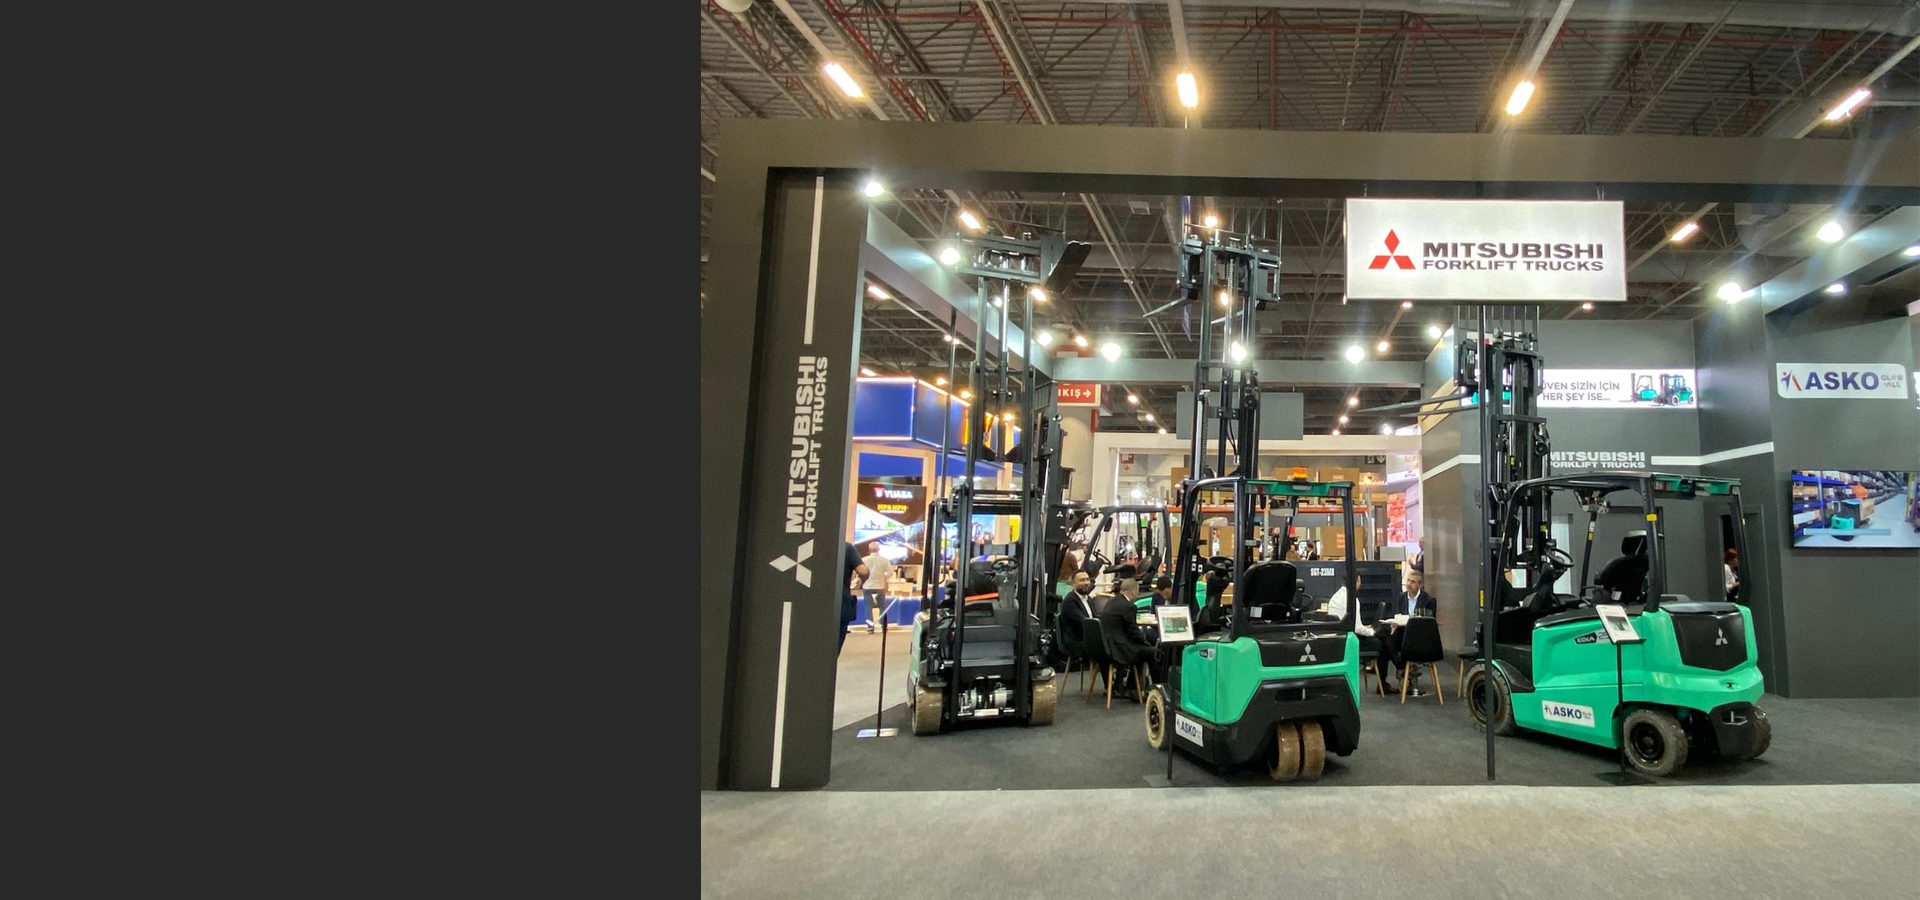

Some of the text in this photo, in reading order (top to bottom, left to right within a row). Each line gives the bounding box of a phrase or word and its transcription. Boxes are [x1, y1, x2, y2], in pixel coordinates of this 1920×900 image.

[1422, 242, 1604, 260] MITSUBISHI
[1422, 260, 1605, 272] FORKLIFT TRUCKS
[1570, 379, 1597, 391] SİZİN
[1599, 379, 1620, 392] İÇİN
[1804, 371, 1880, 391] ASKO
[1542, 392, 1564, 401] HER
[1565, 392, 1585, 402] ŞEY
[785, 356, 816, 533] MITSUBISHI
[803, 356, 828, 533] FORKLIFT TRUCKS
[1550, 451, 1645, 461] MITSUBISHI
[1552, 705, 1583, 720] ASKO
